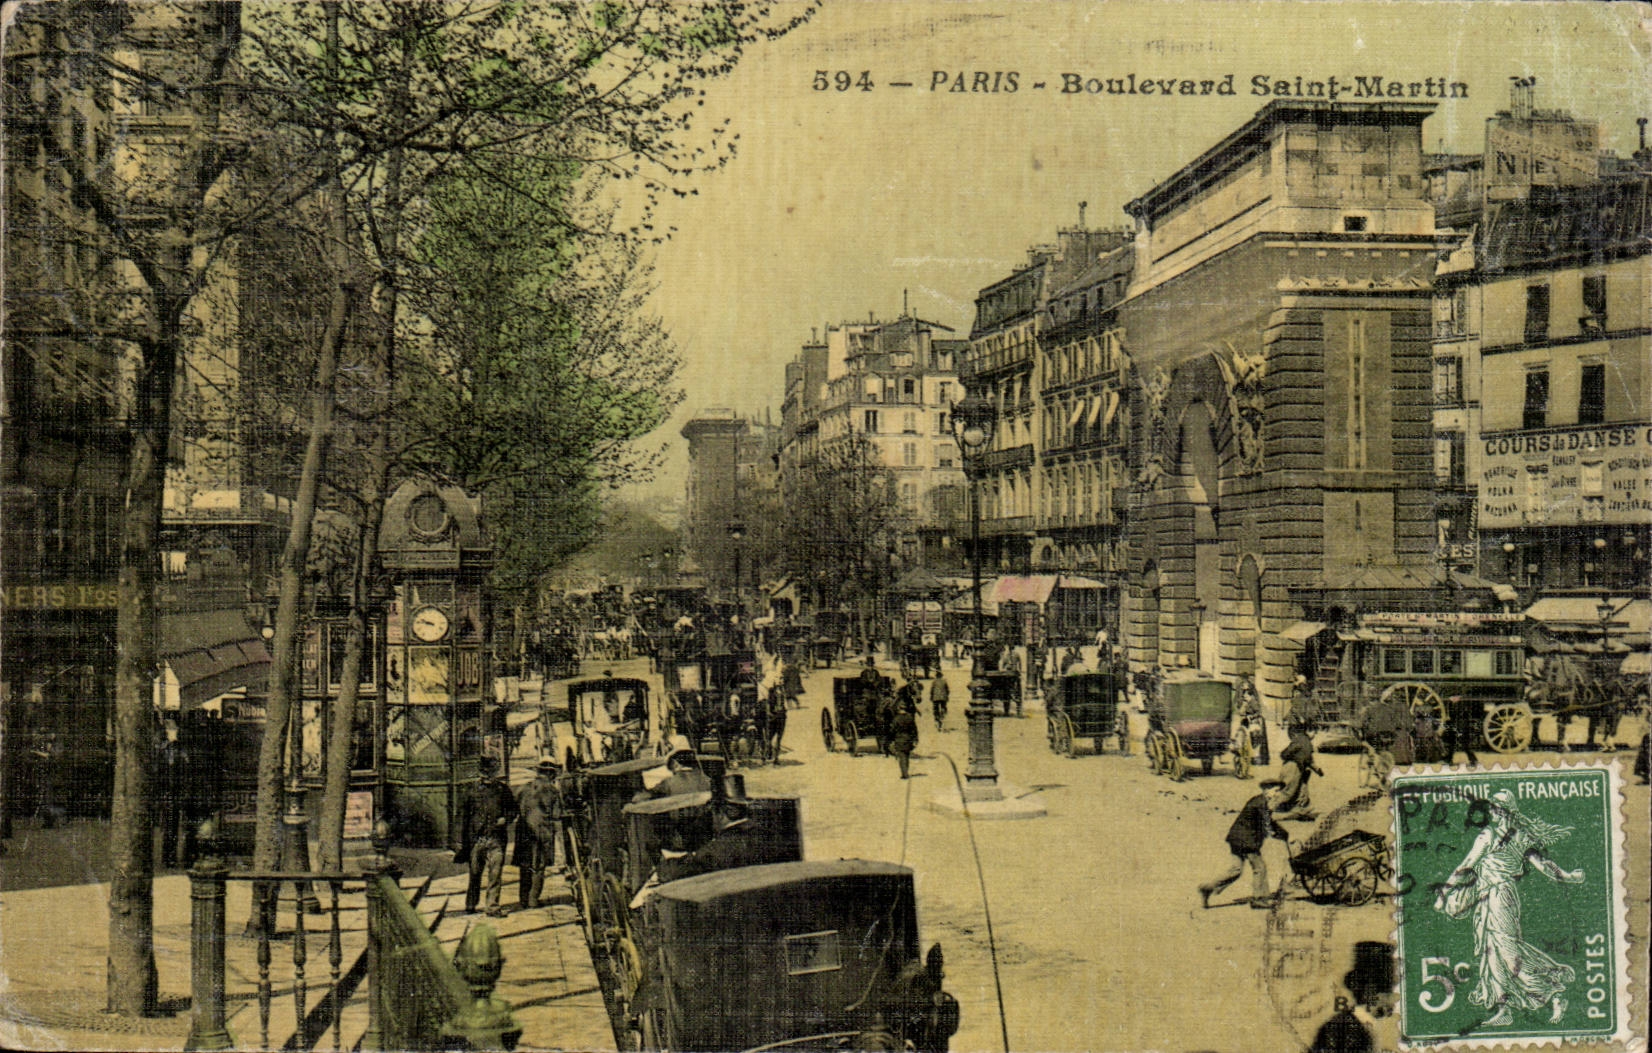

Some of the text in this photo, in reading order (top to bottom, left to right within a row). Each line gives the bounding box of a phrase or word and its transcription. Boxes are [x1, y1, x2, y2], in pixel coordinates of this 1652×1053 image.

[1485, 436, 1551, 457] COURS
[1567, 428, 1636, 450] DANSE
[1517, 779, 1602, 800] FRANÇAISE
[1586, 933, 1607, 1019] POSTES
